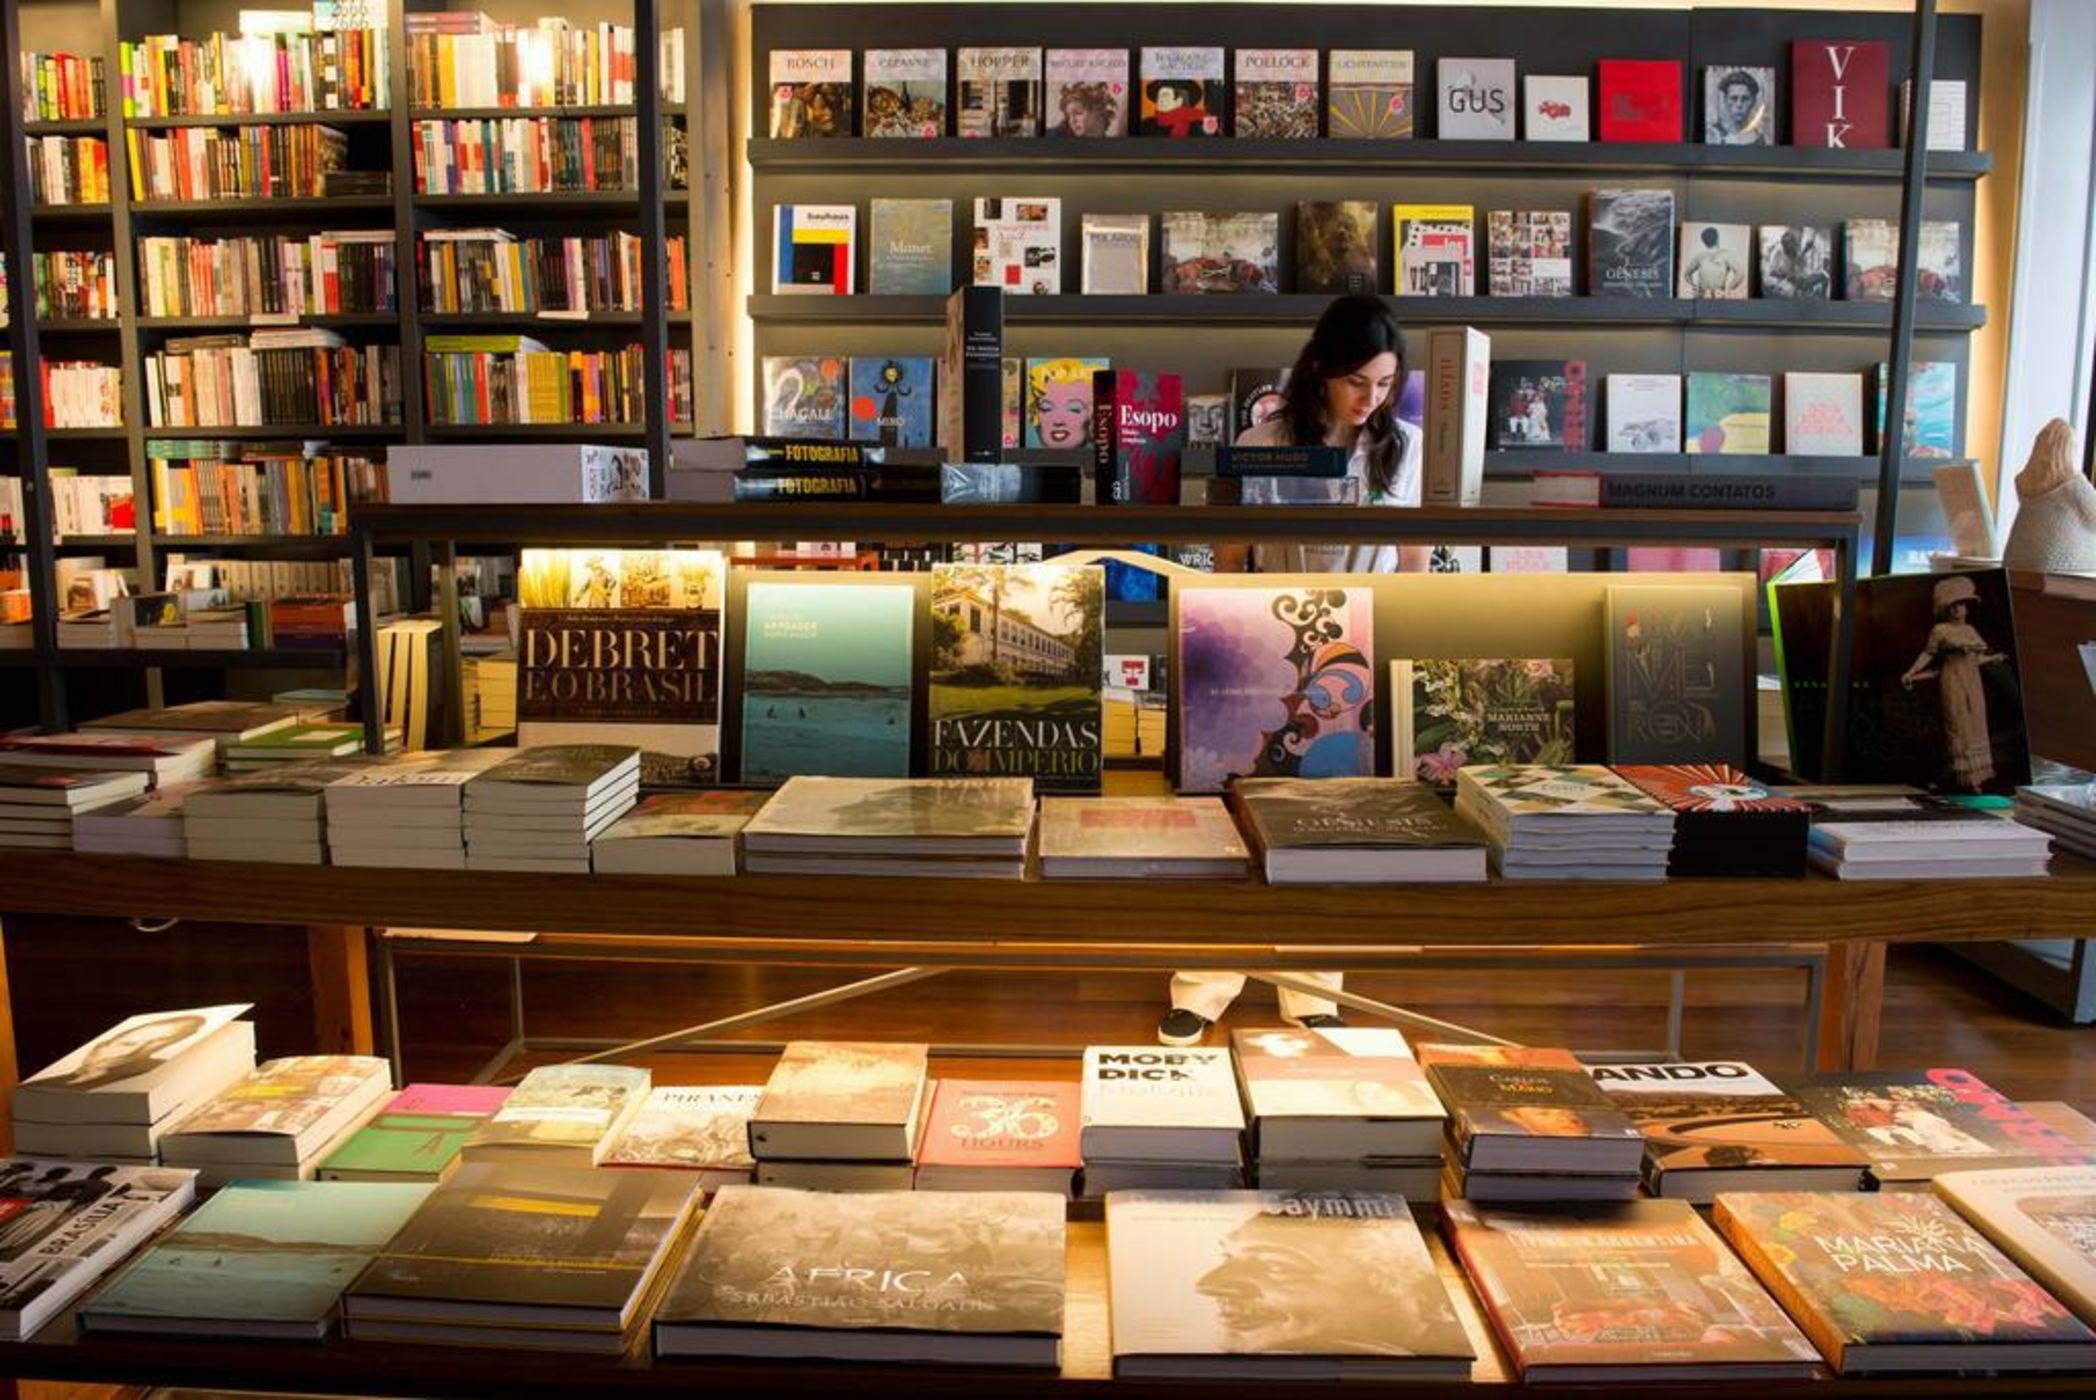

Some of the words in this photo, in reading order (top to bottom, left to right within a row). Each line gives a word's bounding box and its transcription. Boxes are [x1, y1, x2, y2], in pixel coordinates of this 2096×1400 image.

[787, 57, 835, 70] BOSCH
[970, 54, 1030, 69] HOPPER
[1245, 56, 1309, 69] POLLOCK
[1448, 88, 1505, 114] GUS
[889, 240, 933, 255] Monet
[1121, 404, 1178, 433] Esopo
[1097, 404, 1112, 464] Esopo
[785, 444, 859, 463] FOTOGRAFIA
[778, 476, 857, 494] FOTOGRAFIA
[1608, 482, 1686, 500] MAGNUM
[1690, 482, 1776, 500] CONTATOS
[526, 629, 718, 670] DEBRET
[587, 670, 718, 702] BRASIL
[934, 719, 1099, 748] FAZENDAS
[1501, 722, 1540, 733] NORTH
[1098, 1053, 1217, 1065] MOBY
[1593, 1063, 1750, 1082] ANDO
[949, 1095, 1060, 1140] 36
[1814, 1234, 1985, 1257] MARIANA
[1832, 1253, 1973, 1273] PALMA
